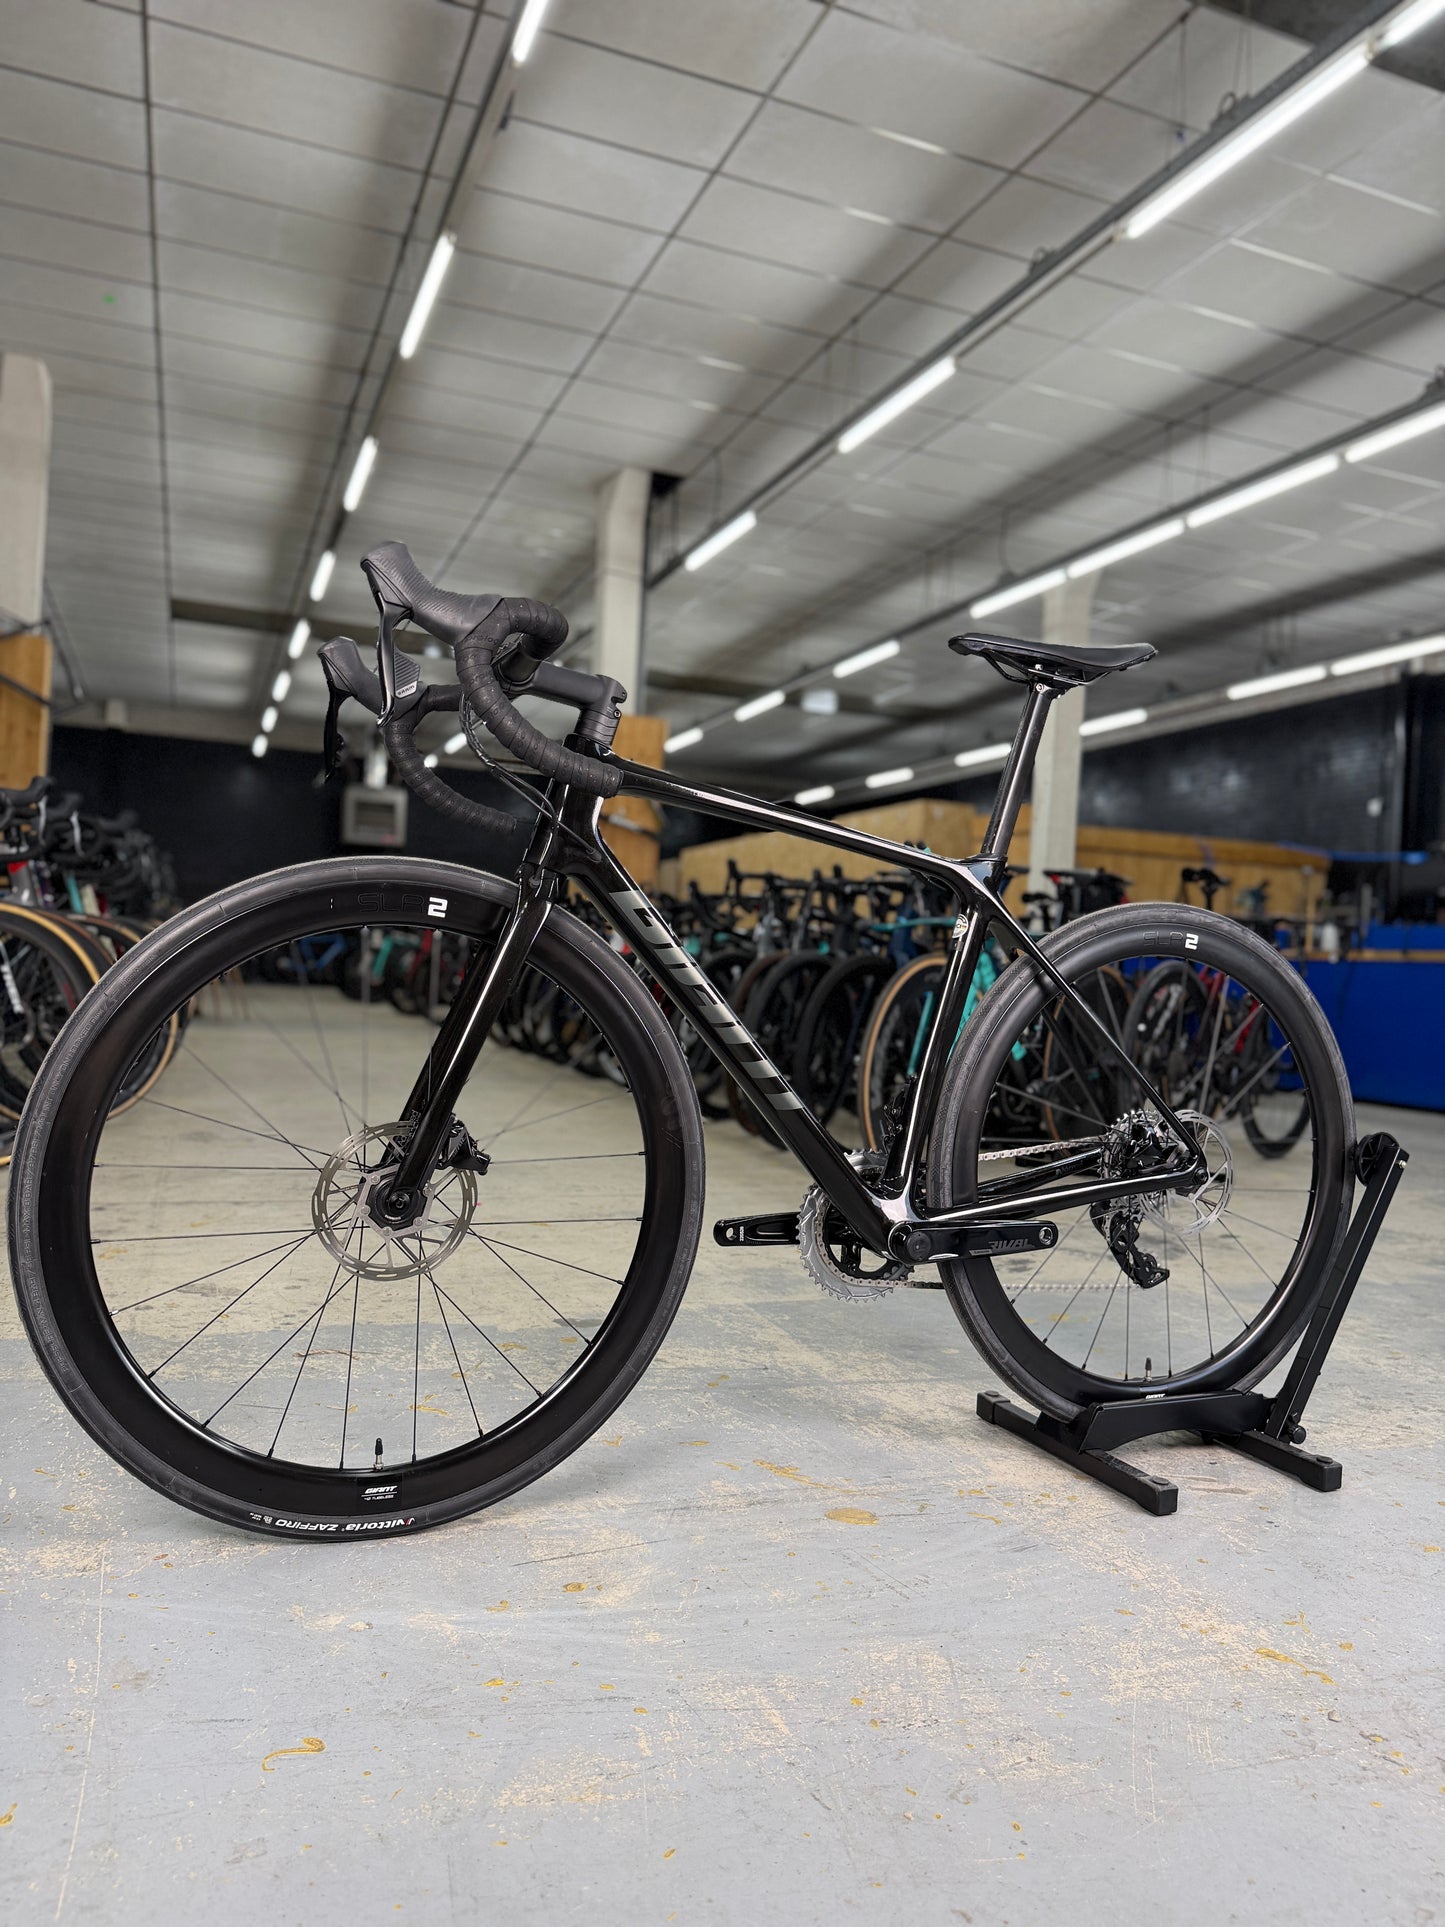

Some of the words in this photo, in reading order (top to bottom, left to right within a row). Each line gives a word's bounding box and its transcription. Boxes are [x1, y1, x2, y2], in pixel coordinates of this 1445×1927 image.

[988, 1238, 1035, 1250] RIVAL
[364, 1485, 399, 1495] GIANT
[275, 1518, 339, 1531] ZAFFIRO
